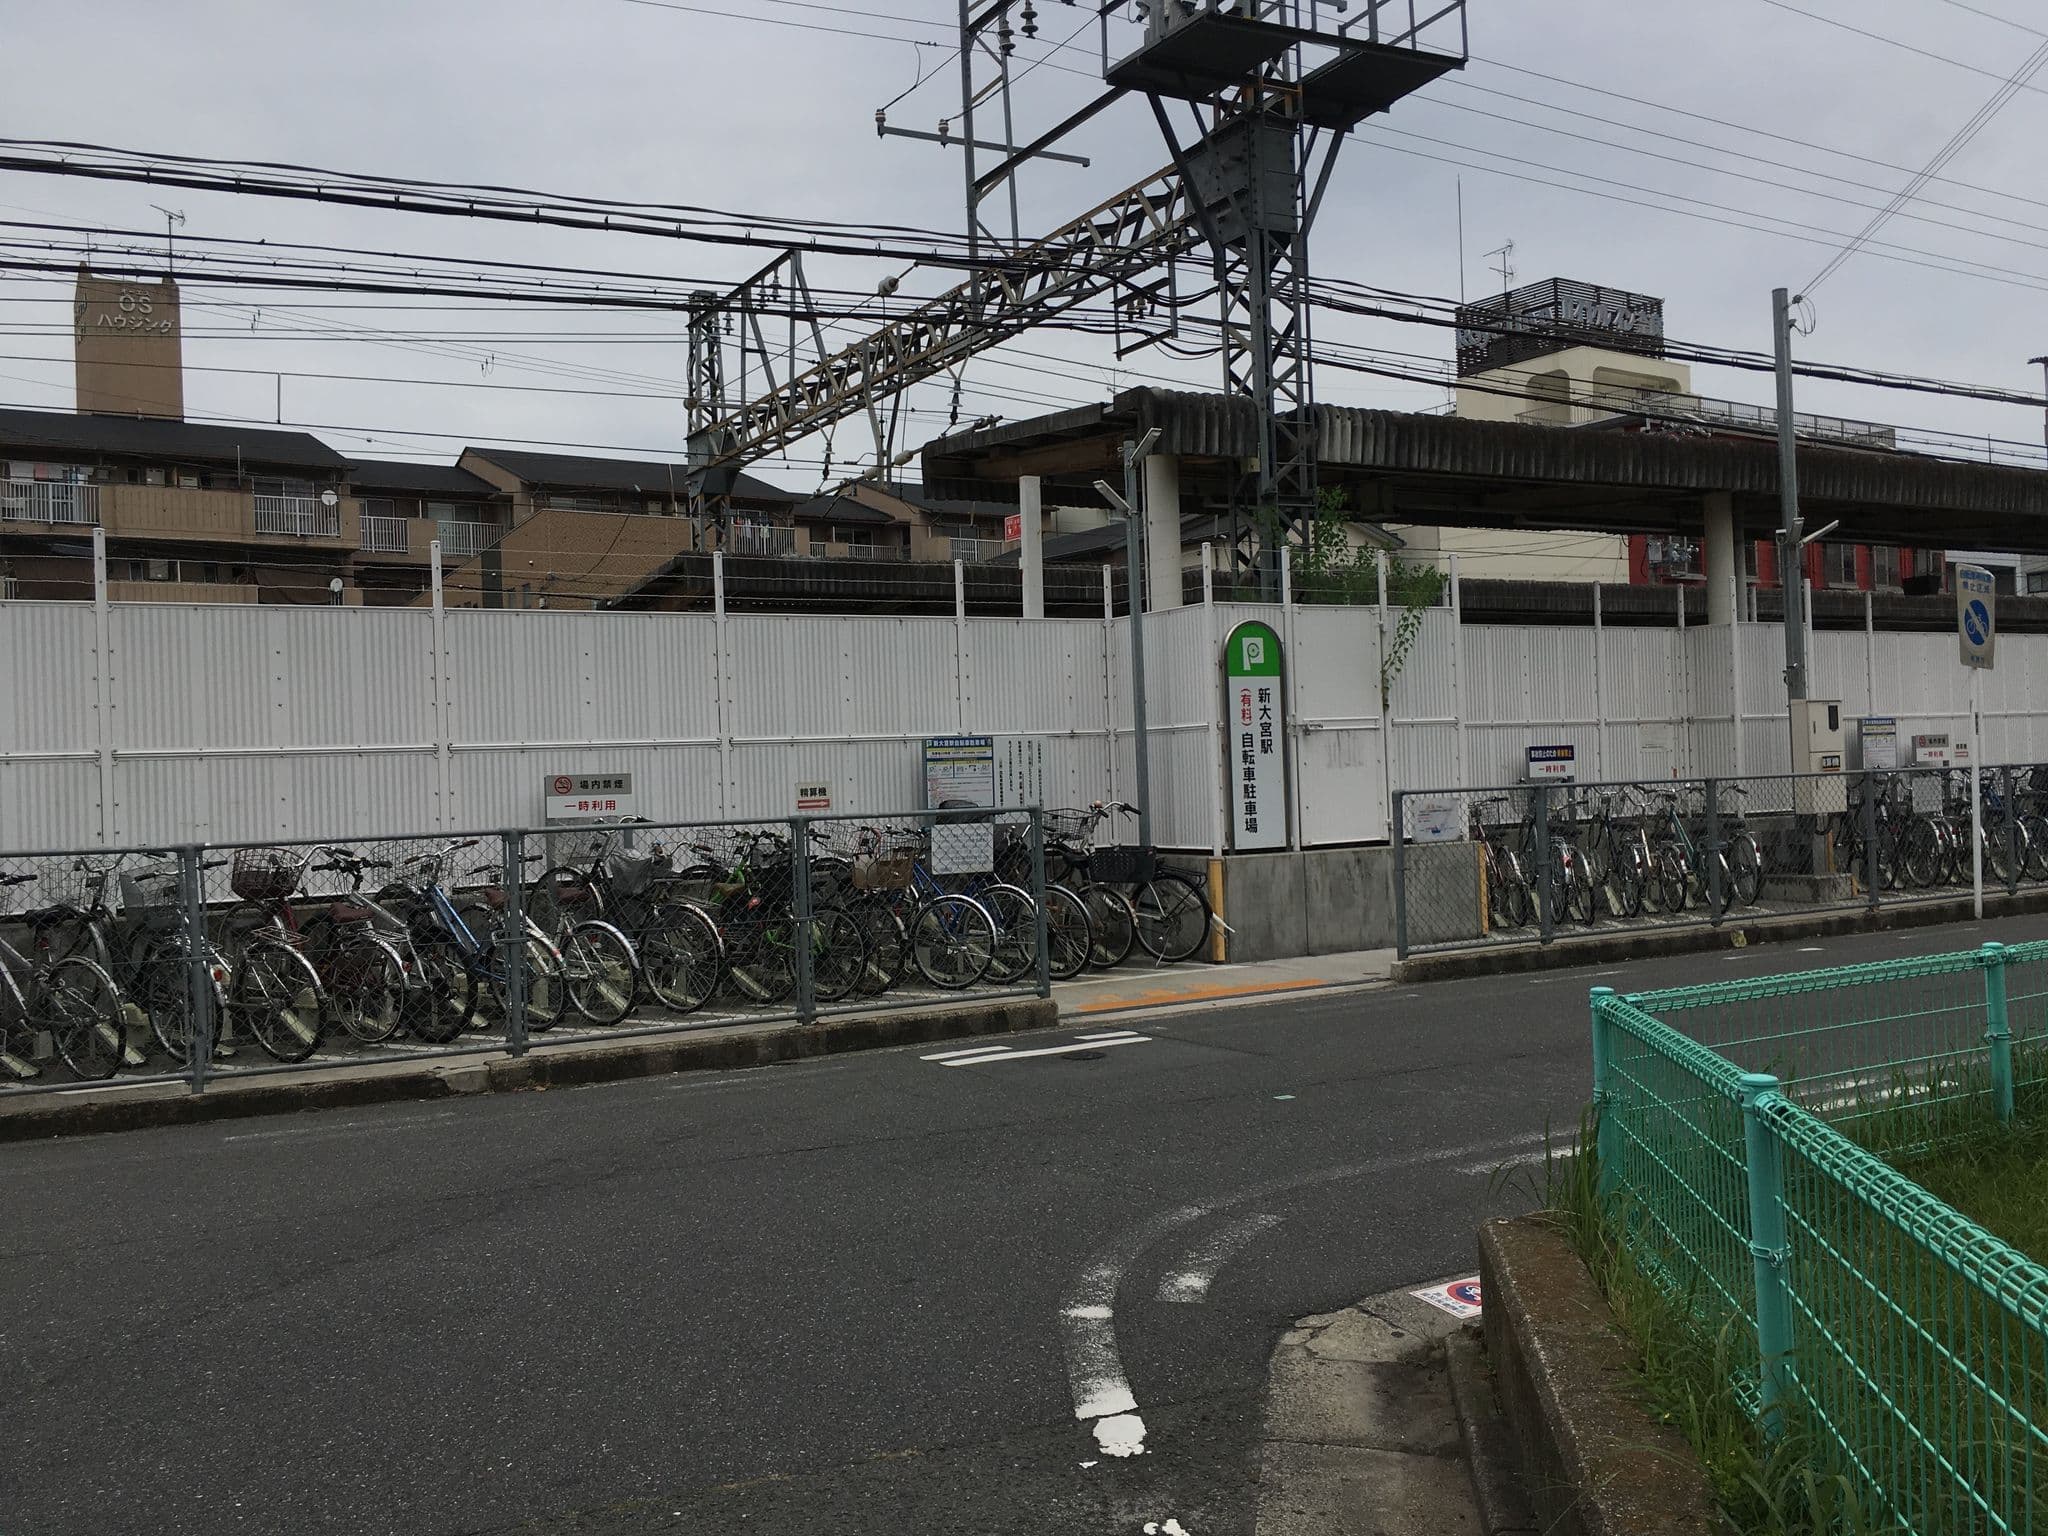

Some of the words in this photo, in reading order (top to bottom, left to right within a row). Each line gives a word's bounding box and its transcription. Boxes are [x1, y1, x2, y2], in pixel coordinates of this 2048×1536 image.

[120, 294, 152, 313] OS
[97, 313, 174, 333] ハウジング
[1258, 687, 1273, 754] 新大宮駅
[1538, 764, 1566, 773] 一時利用
[1242, 732, 1258, 833] 自転車駐車場
[564, 800, 616, 811] 一時利用
